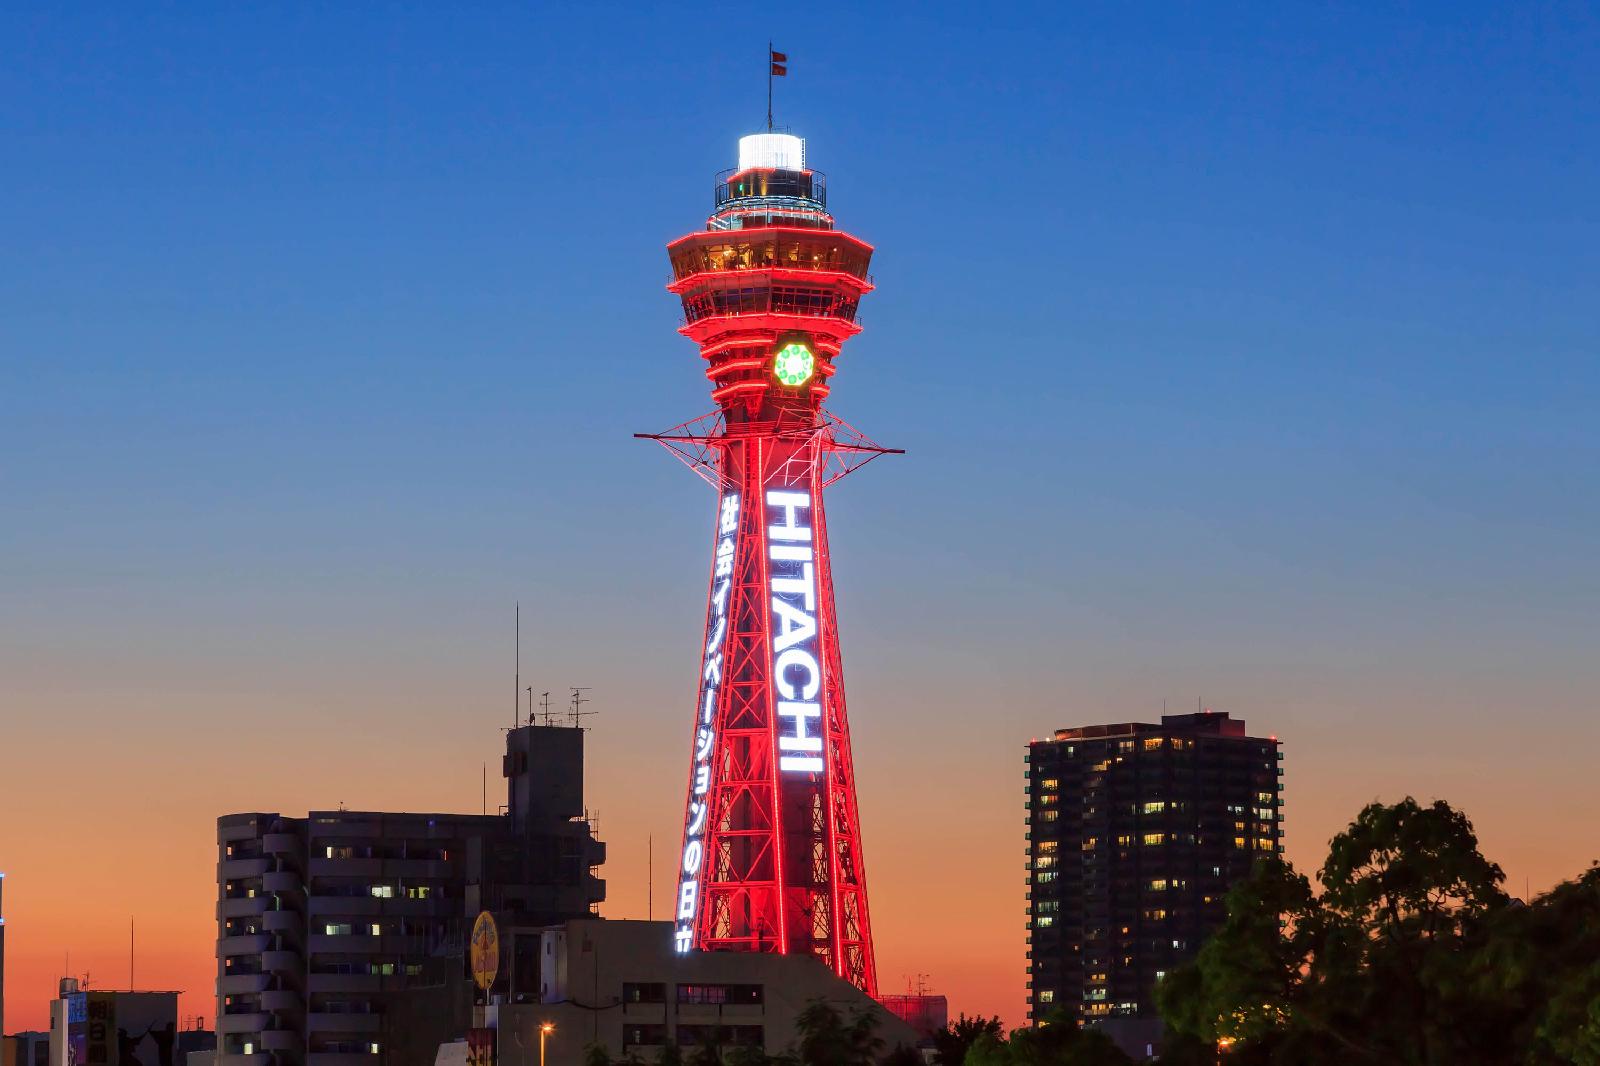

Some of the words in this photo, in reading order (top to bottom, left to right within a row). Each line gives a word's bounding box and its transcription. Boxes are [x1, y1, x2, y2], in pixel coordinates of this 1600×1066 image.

[675, 494, 739, 953] 社会イノベーションの日立
[766, 490, 824, 772] HITACHI
